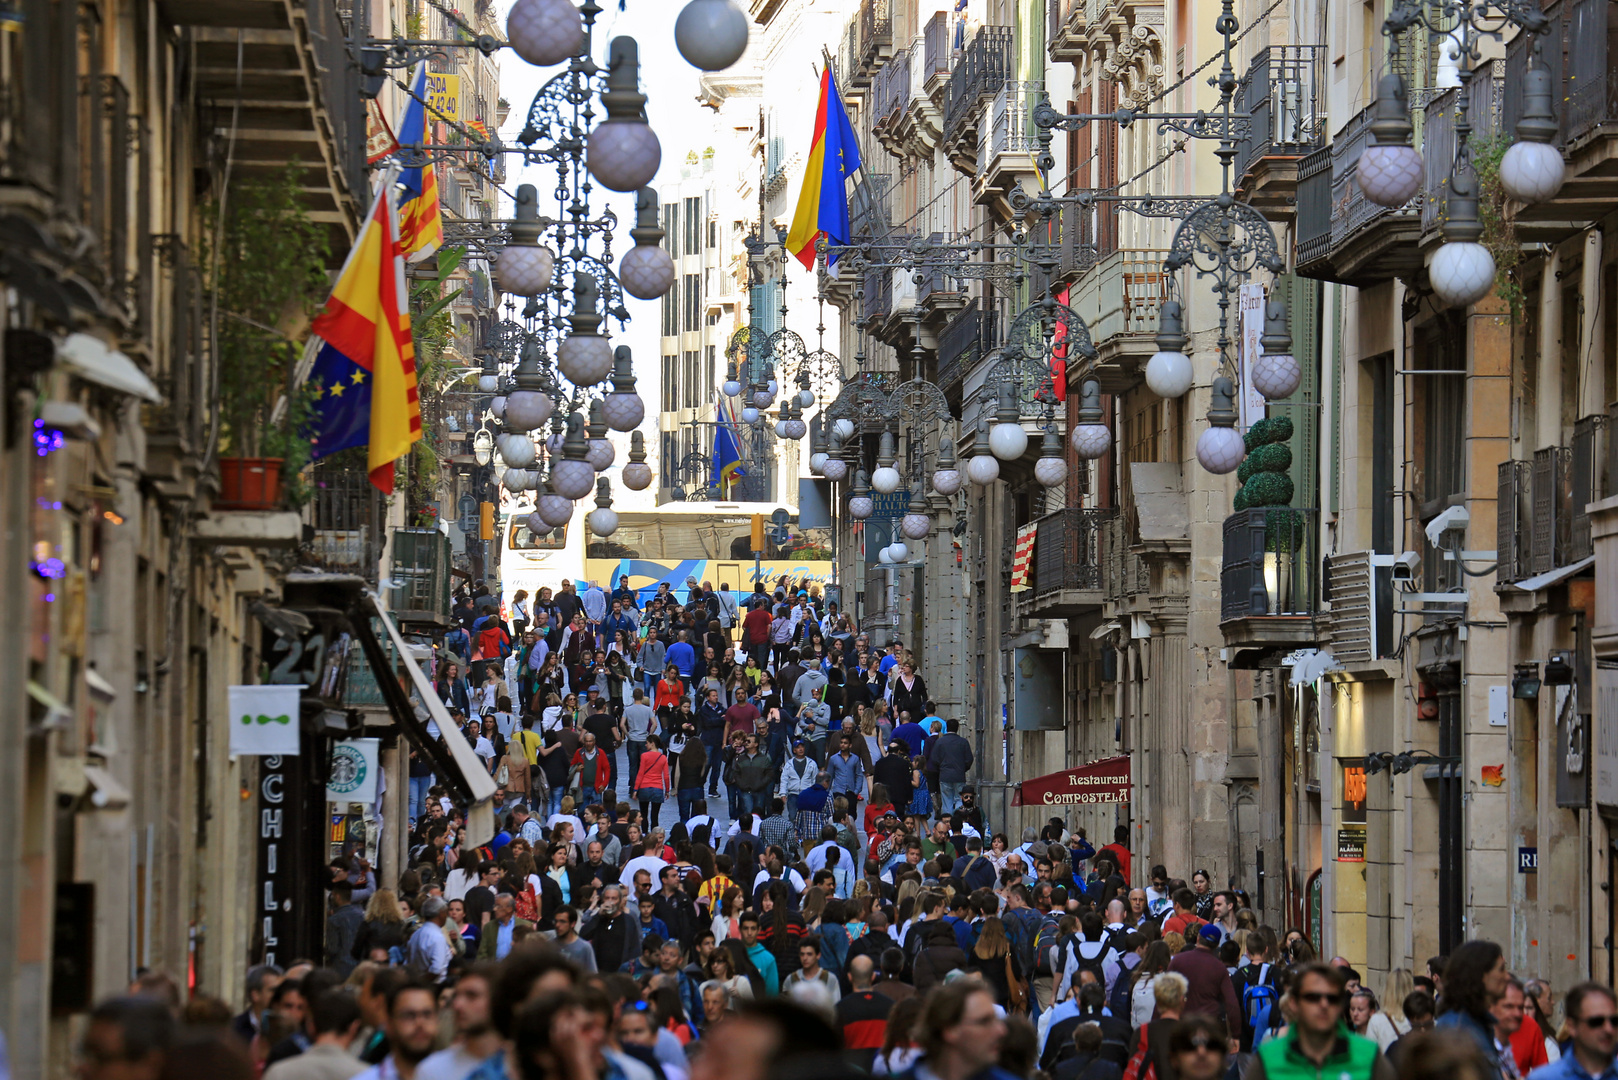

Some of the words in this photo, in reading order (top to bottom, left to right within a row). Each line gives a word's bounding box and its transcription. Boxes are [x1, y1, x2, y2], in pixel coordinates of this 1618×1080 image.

[436, 95, 445, 113] 42
[446, 96, 456, 114] 40
[870, 492, 907, 502] HOTEL
[1068, 774, 1129, 786] Restaurant
[1042, 788, 1128, 805] COMPOSTELA
